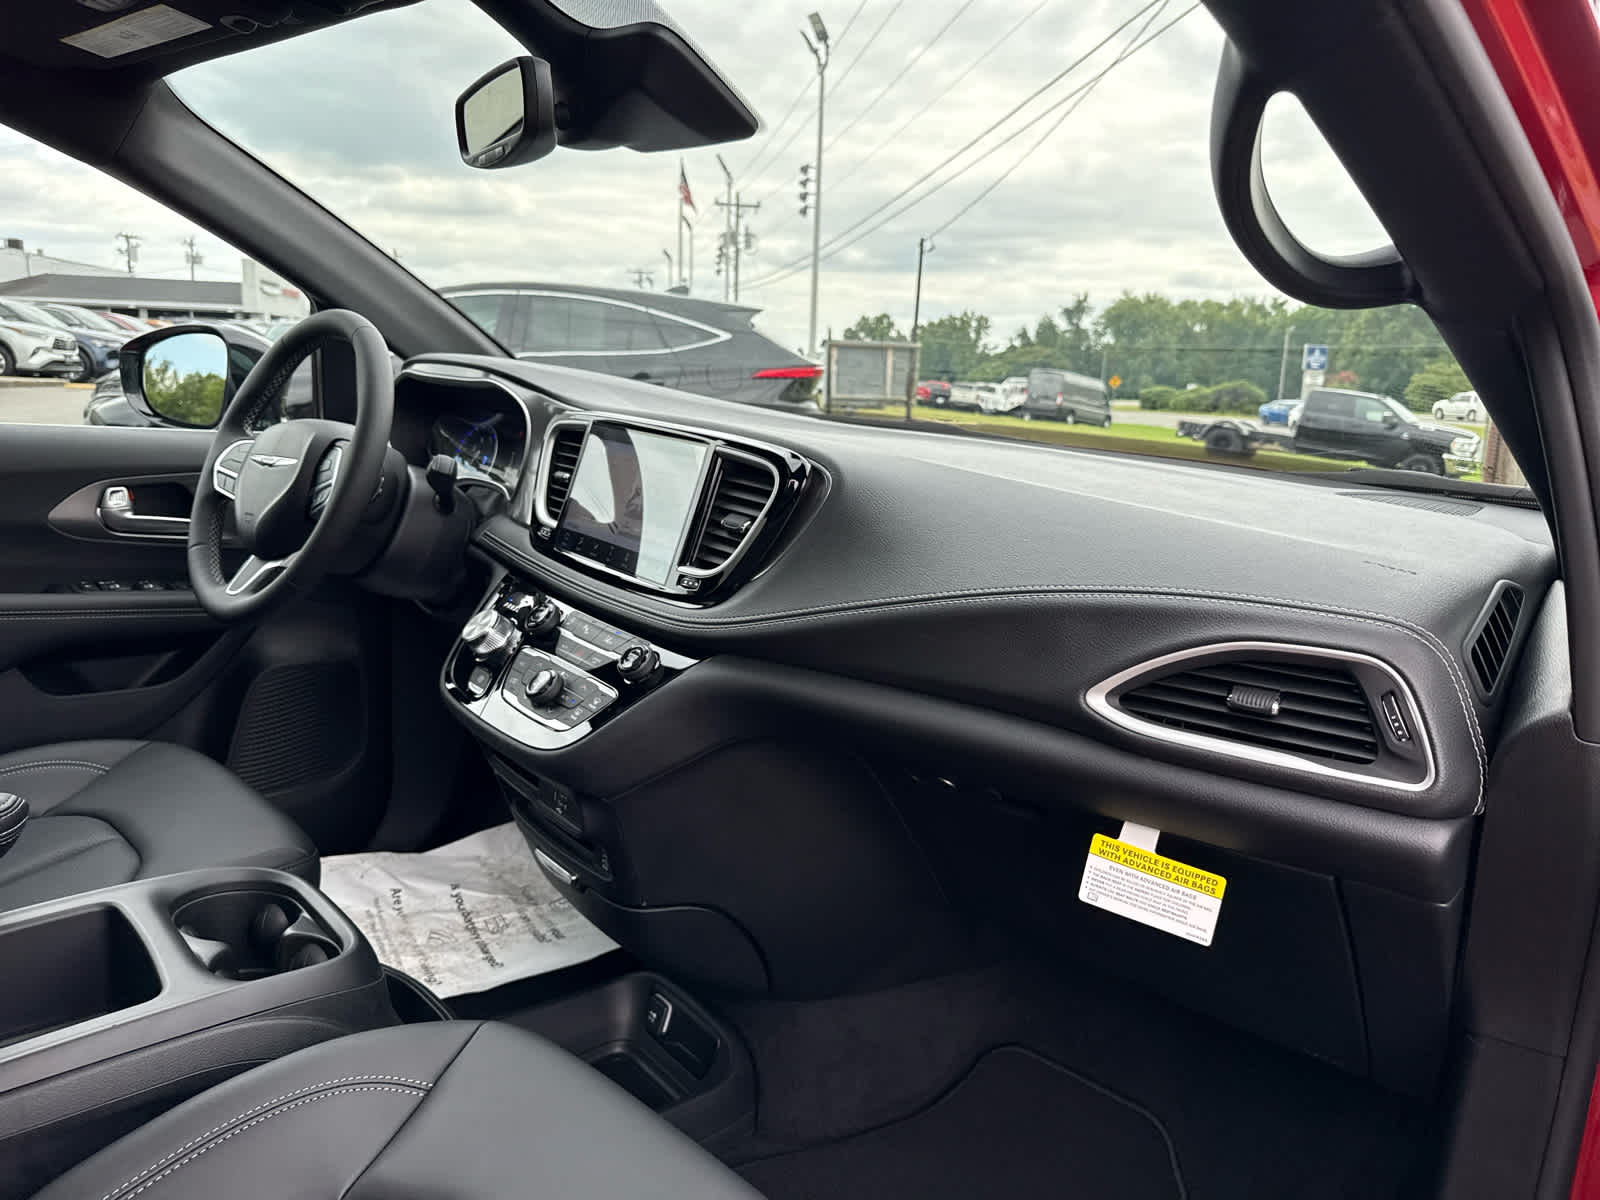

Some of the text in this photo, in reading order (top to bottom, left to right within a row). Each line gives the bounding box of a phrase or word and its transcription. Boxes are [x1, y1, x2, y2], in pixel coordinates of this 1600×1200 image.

[1098, 848, 1216, 895] WITH ADVANCED AIR BAGS
[1100, 839, 1218, 887] THIS VEHICLE IS EQUIPPED
[390, 888, 402, 905] Are
